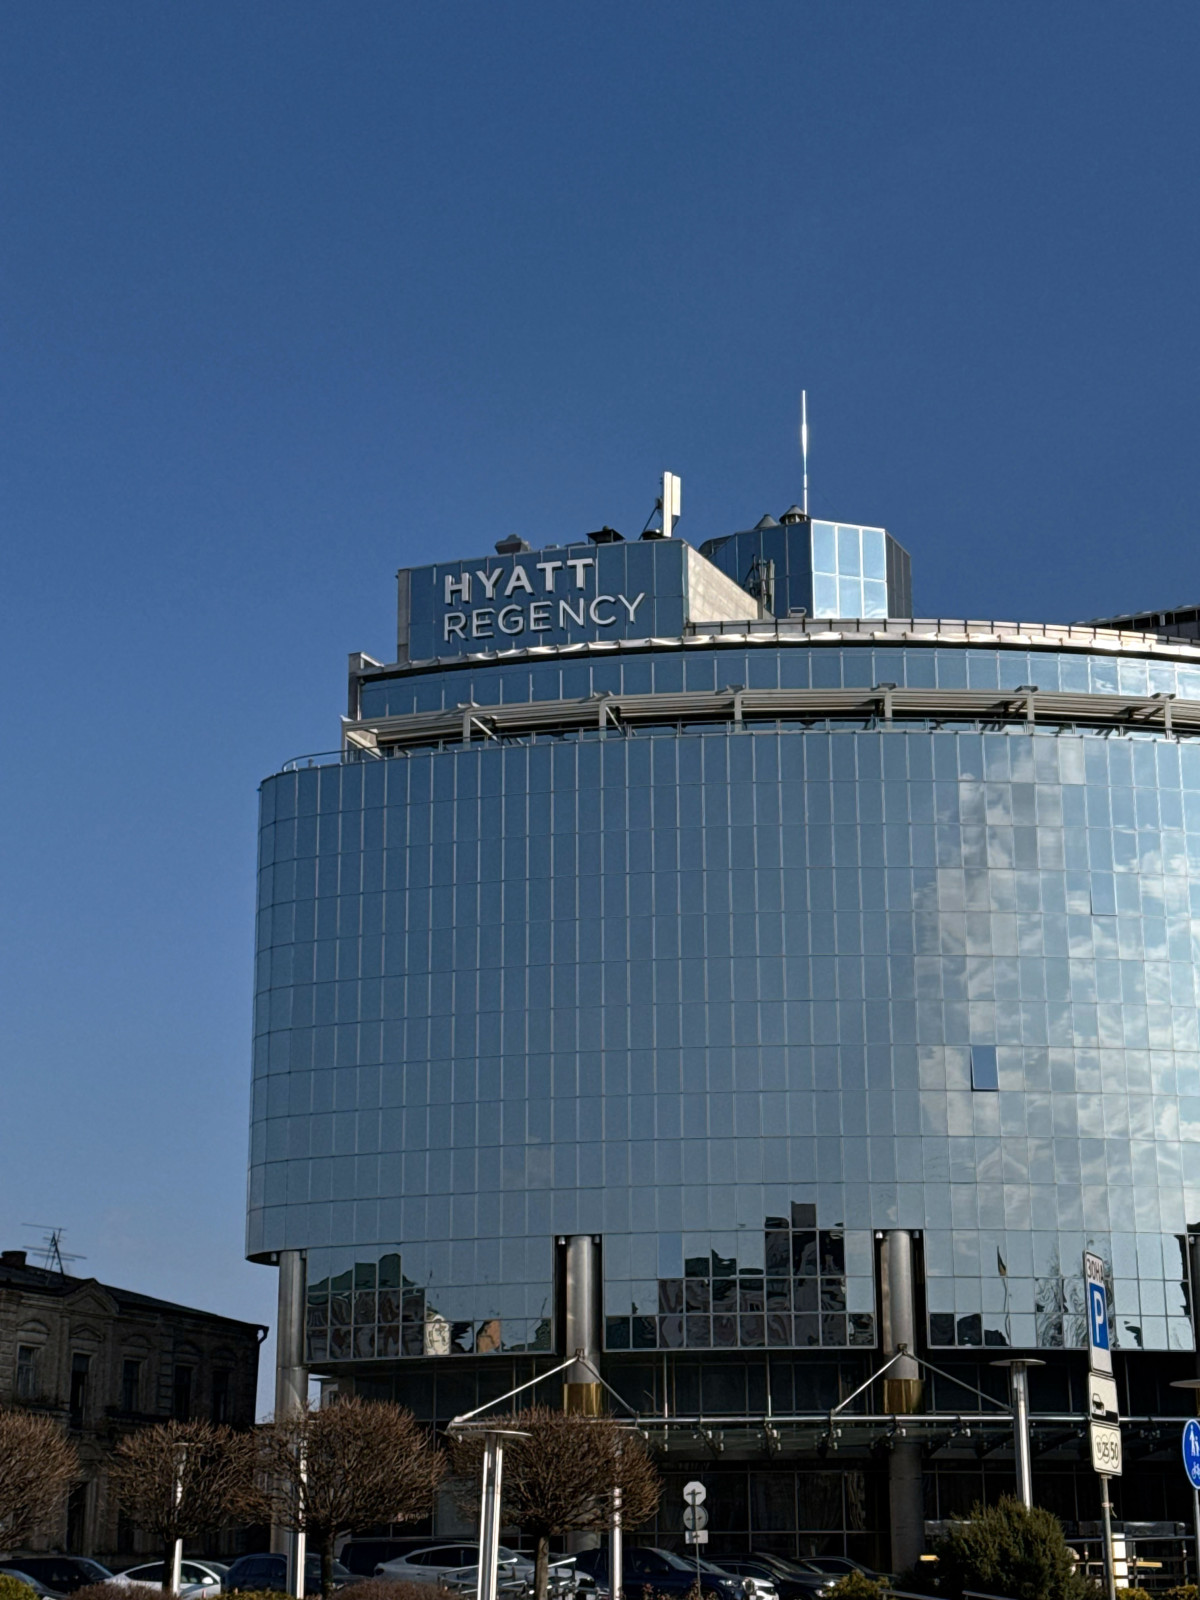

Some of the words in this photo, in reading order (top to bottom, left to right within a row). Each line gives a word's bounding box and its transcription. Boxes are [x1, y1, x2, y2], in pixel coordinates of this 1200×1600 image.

[444, 558, 596, 605] HYATT
[443, 592, 646, 642] REGENCY
[1093, 1290, 1104, 1344] P
[1110, 1441, 1119, 1461] 50
